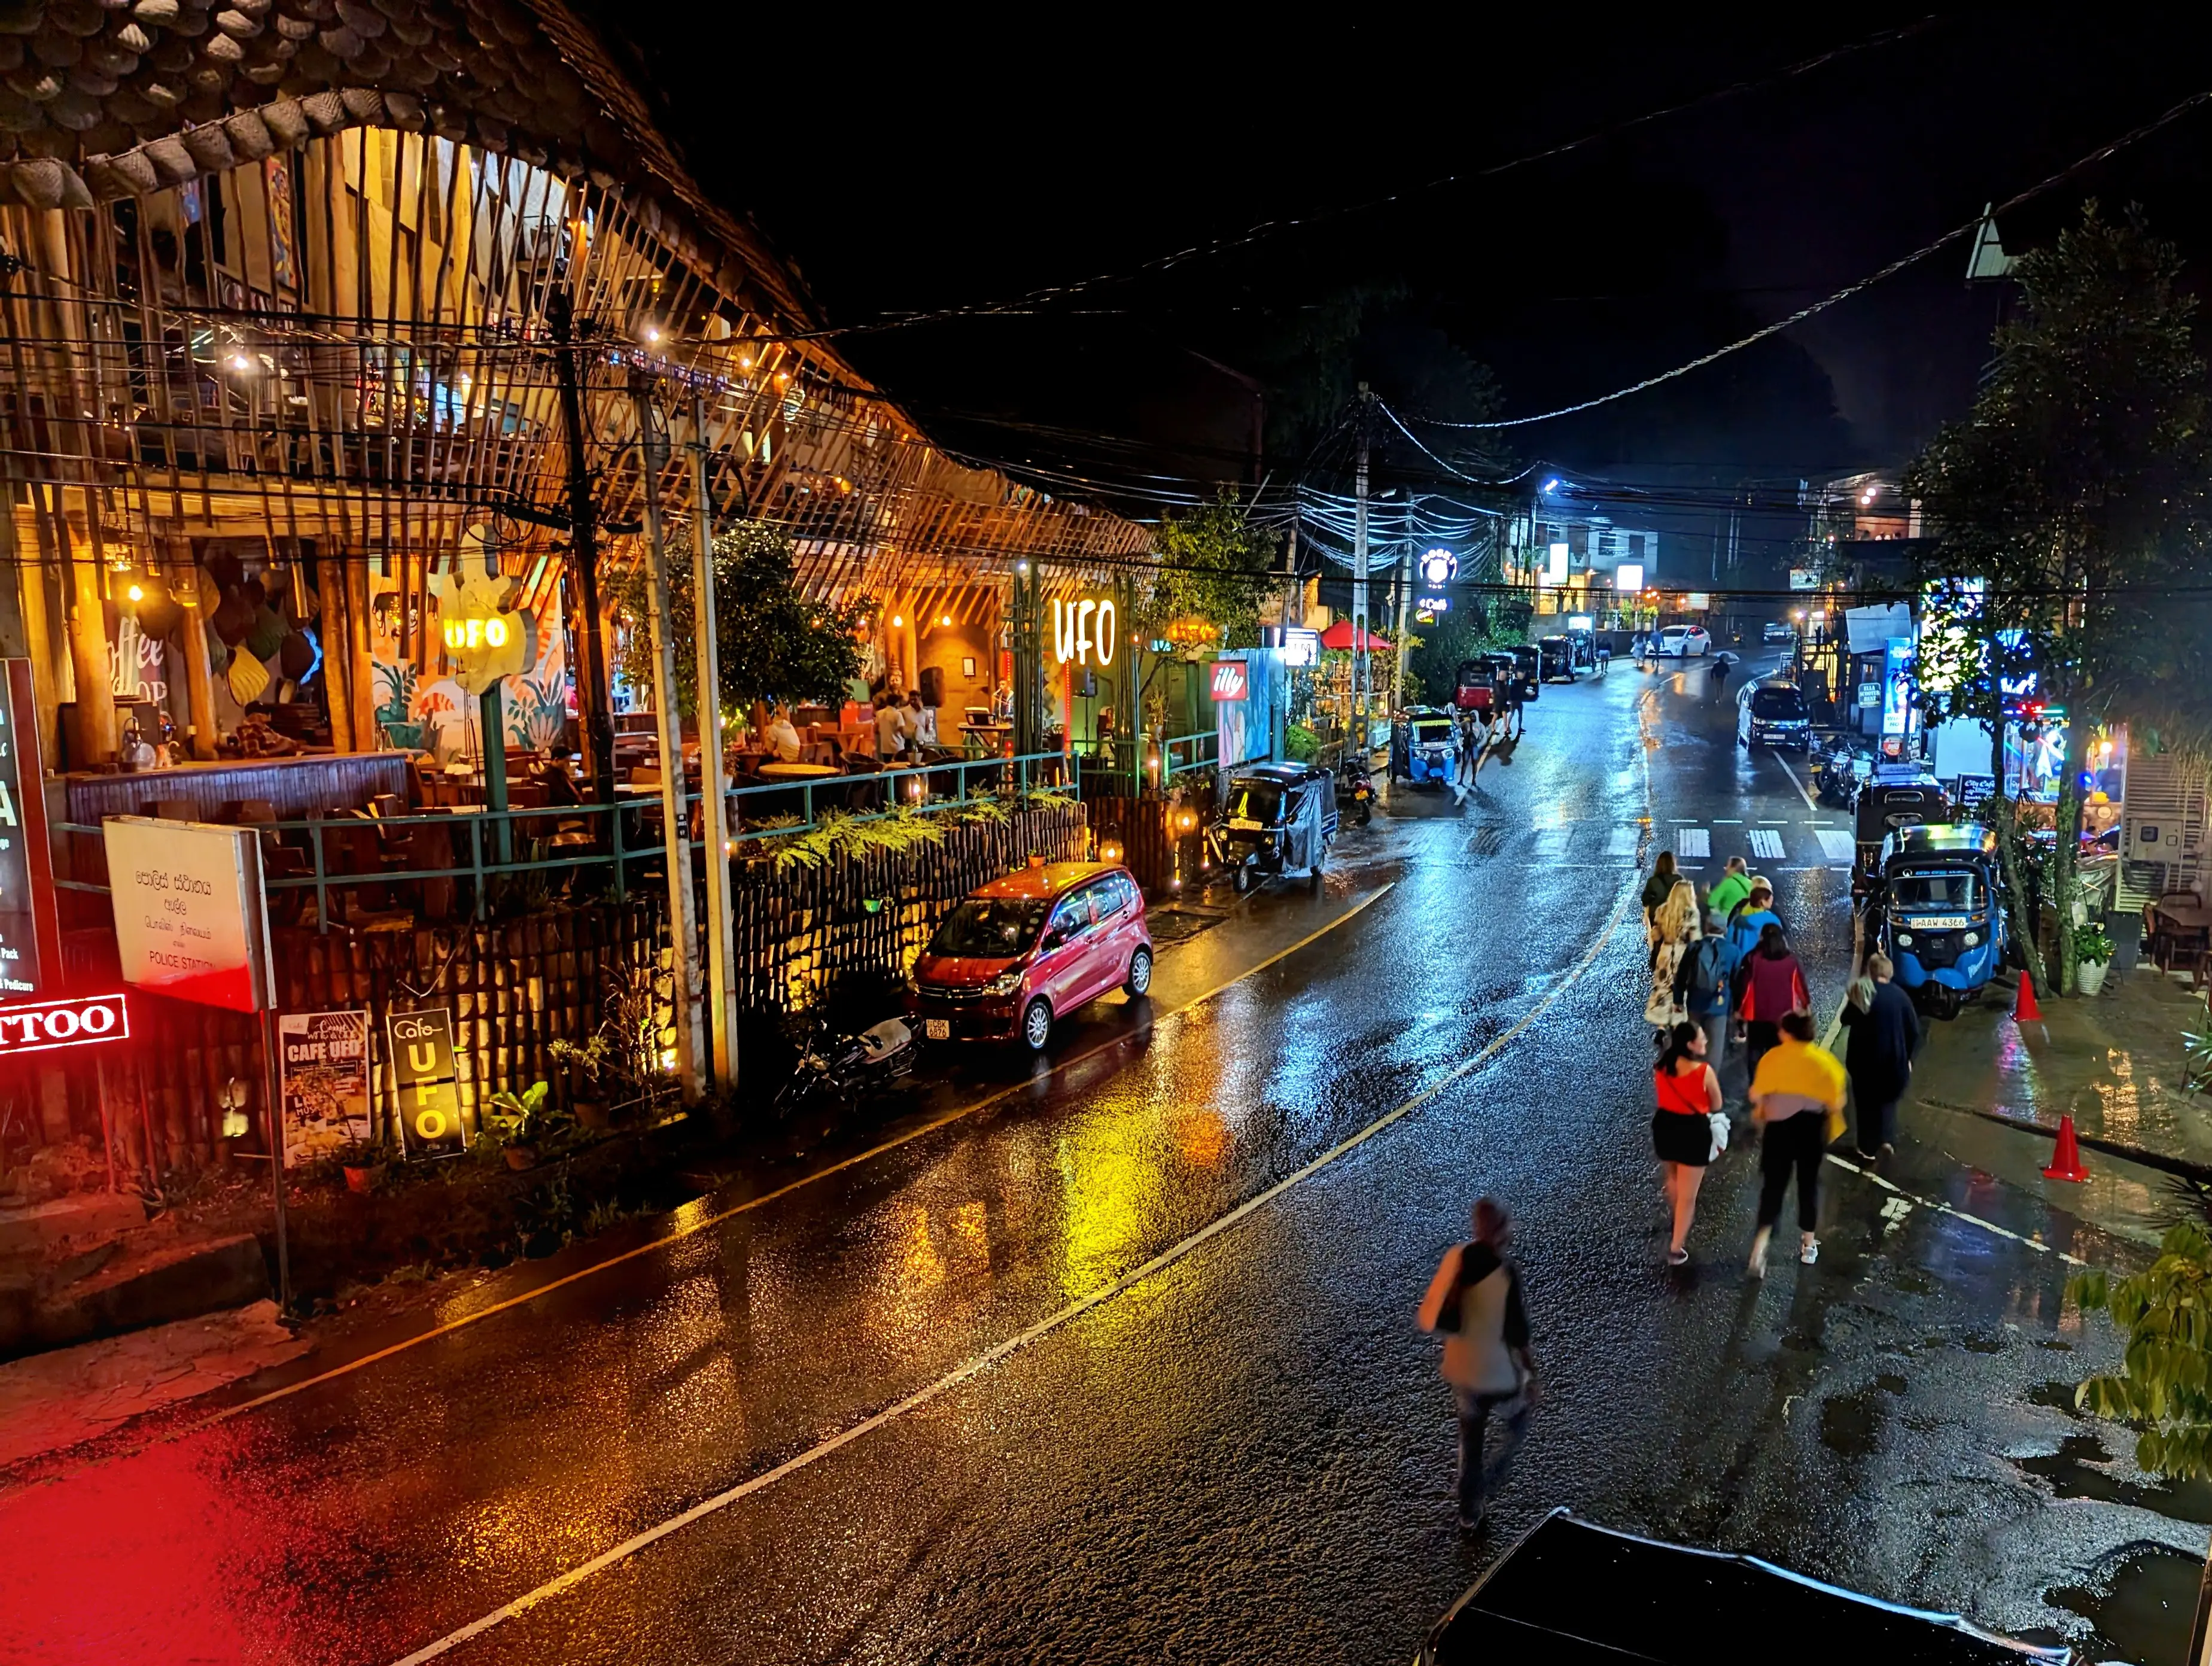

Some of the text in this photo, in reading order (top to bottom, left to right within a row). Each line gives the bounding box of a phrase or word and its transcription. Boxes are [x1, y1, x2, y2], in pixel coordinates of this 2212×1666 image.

[443, 617, 509, 648] UFO
[1054, 598, 1115, 665] UFO
[1213, 667, 1244, 697] illy
[1921, 919, 1939, 927] AAW
[1, 947, 19, 959] Pack
[150, 951, 179, 968] POLICE
[4, 978, 34, 992] Pedicure
[394, 1018, 443, 1039] Cafe
[930, 1028, 947, 1037] 6876
[933, 1020, 946, 1028] CBK
[287, 1039, 360, 1062] CAFE UFO
[408, 1042, 446, 1139] UFO
